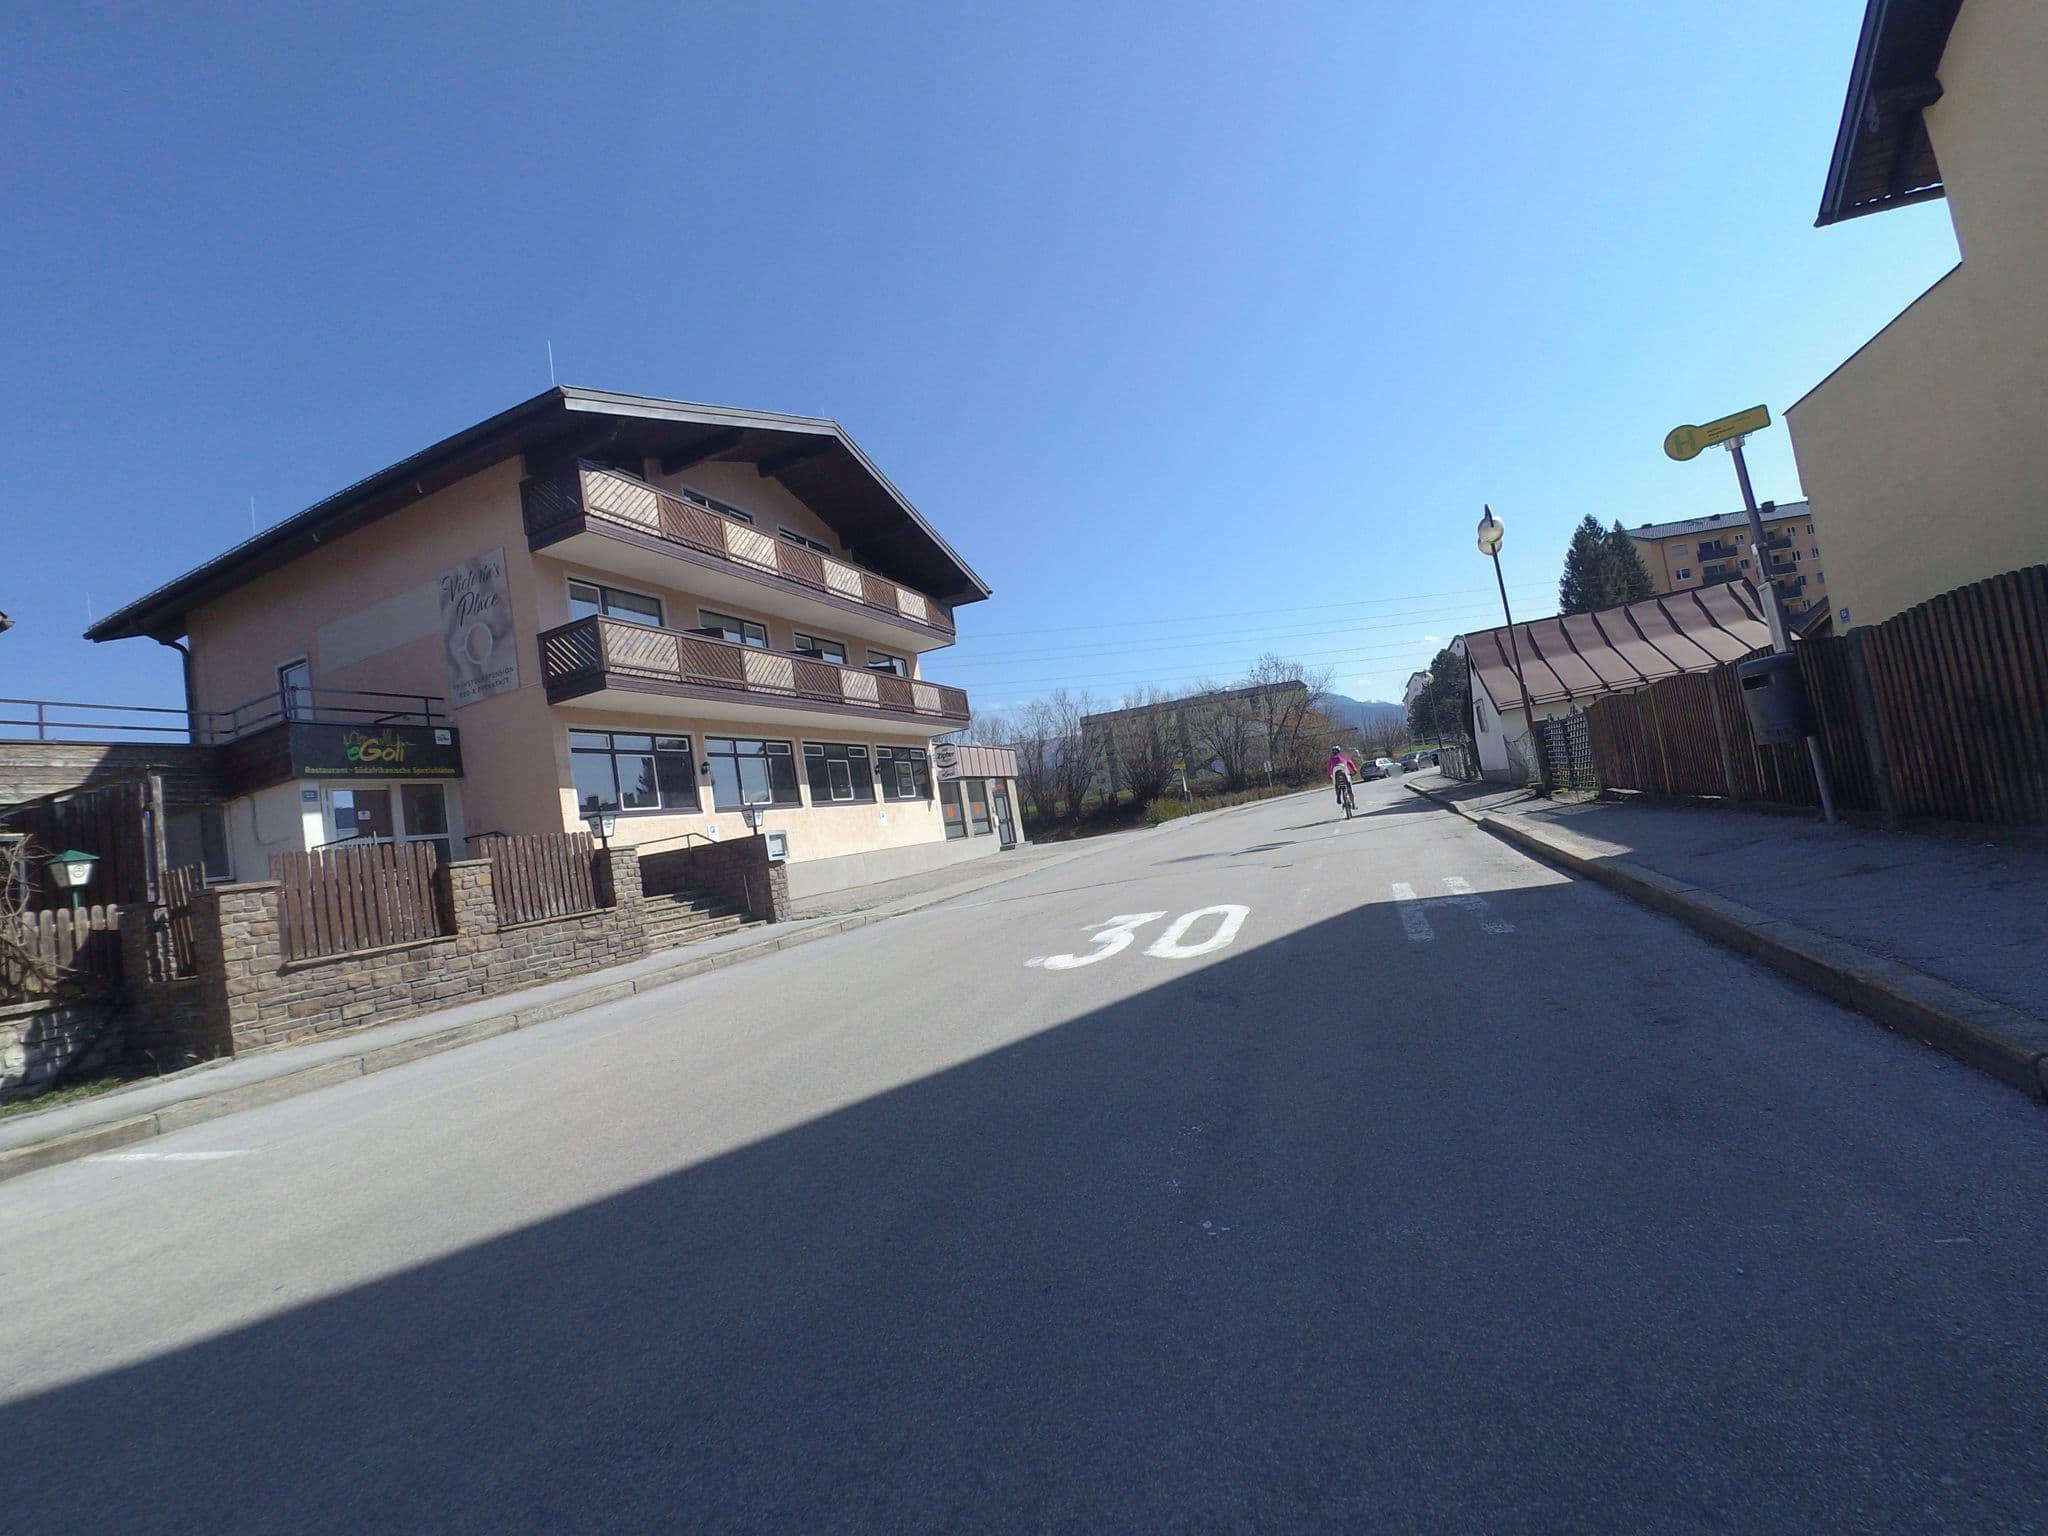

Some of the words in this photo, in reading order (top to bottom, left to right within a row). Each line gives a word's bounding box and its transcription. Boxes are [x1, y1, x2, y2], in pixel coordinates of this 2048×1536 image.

[1674, 429, 1696, 456] H
[441, 563, 500, 602] Victoria's
[456, 591, 499, 627] Place
[346, 738, 405, 762] eGoli
[304, 766, 348, 774] Restaurant
[1023, 904, 1251, 970] 30
